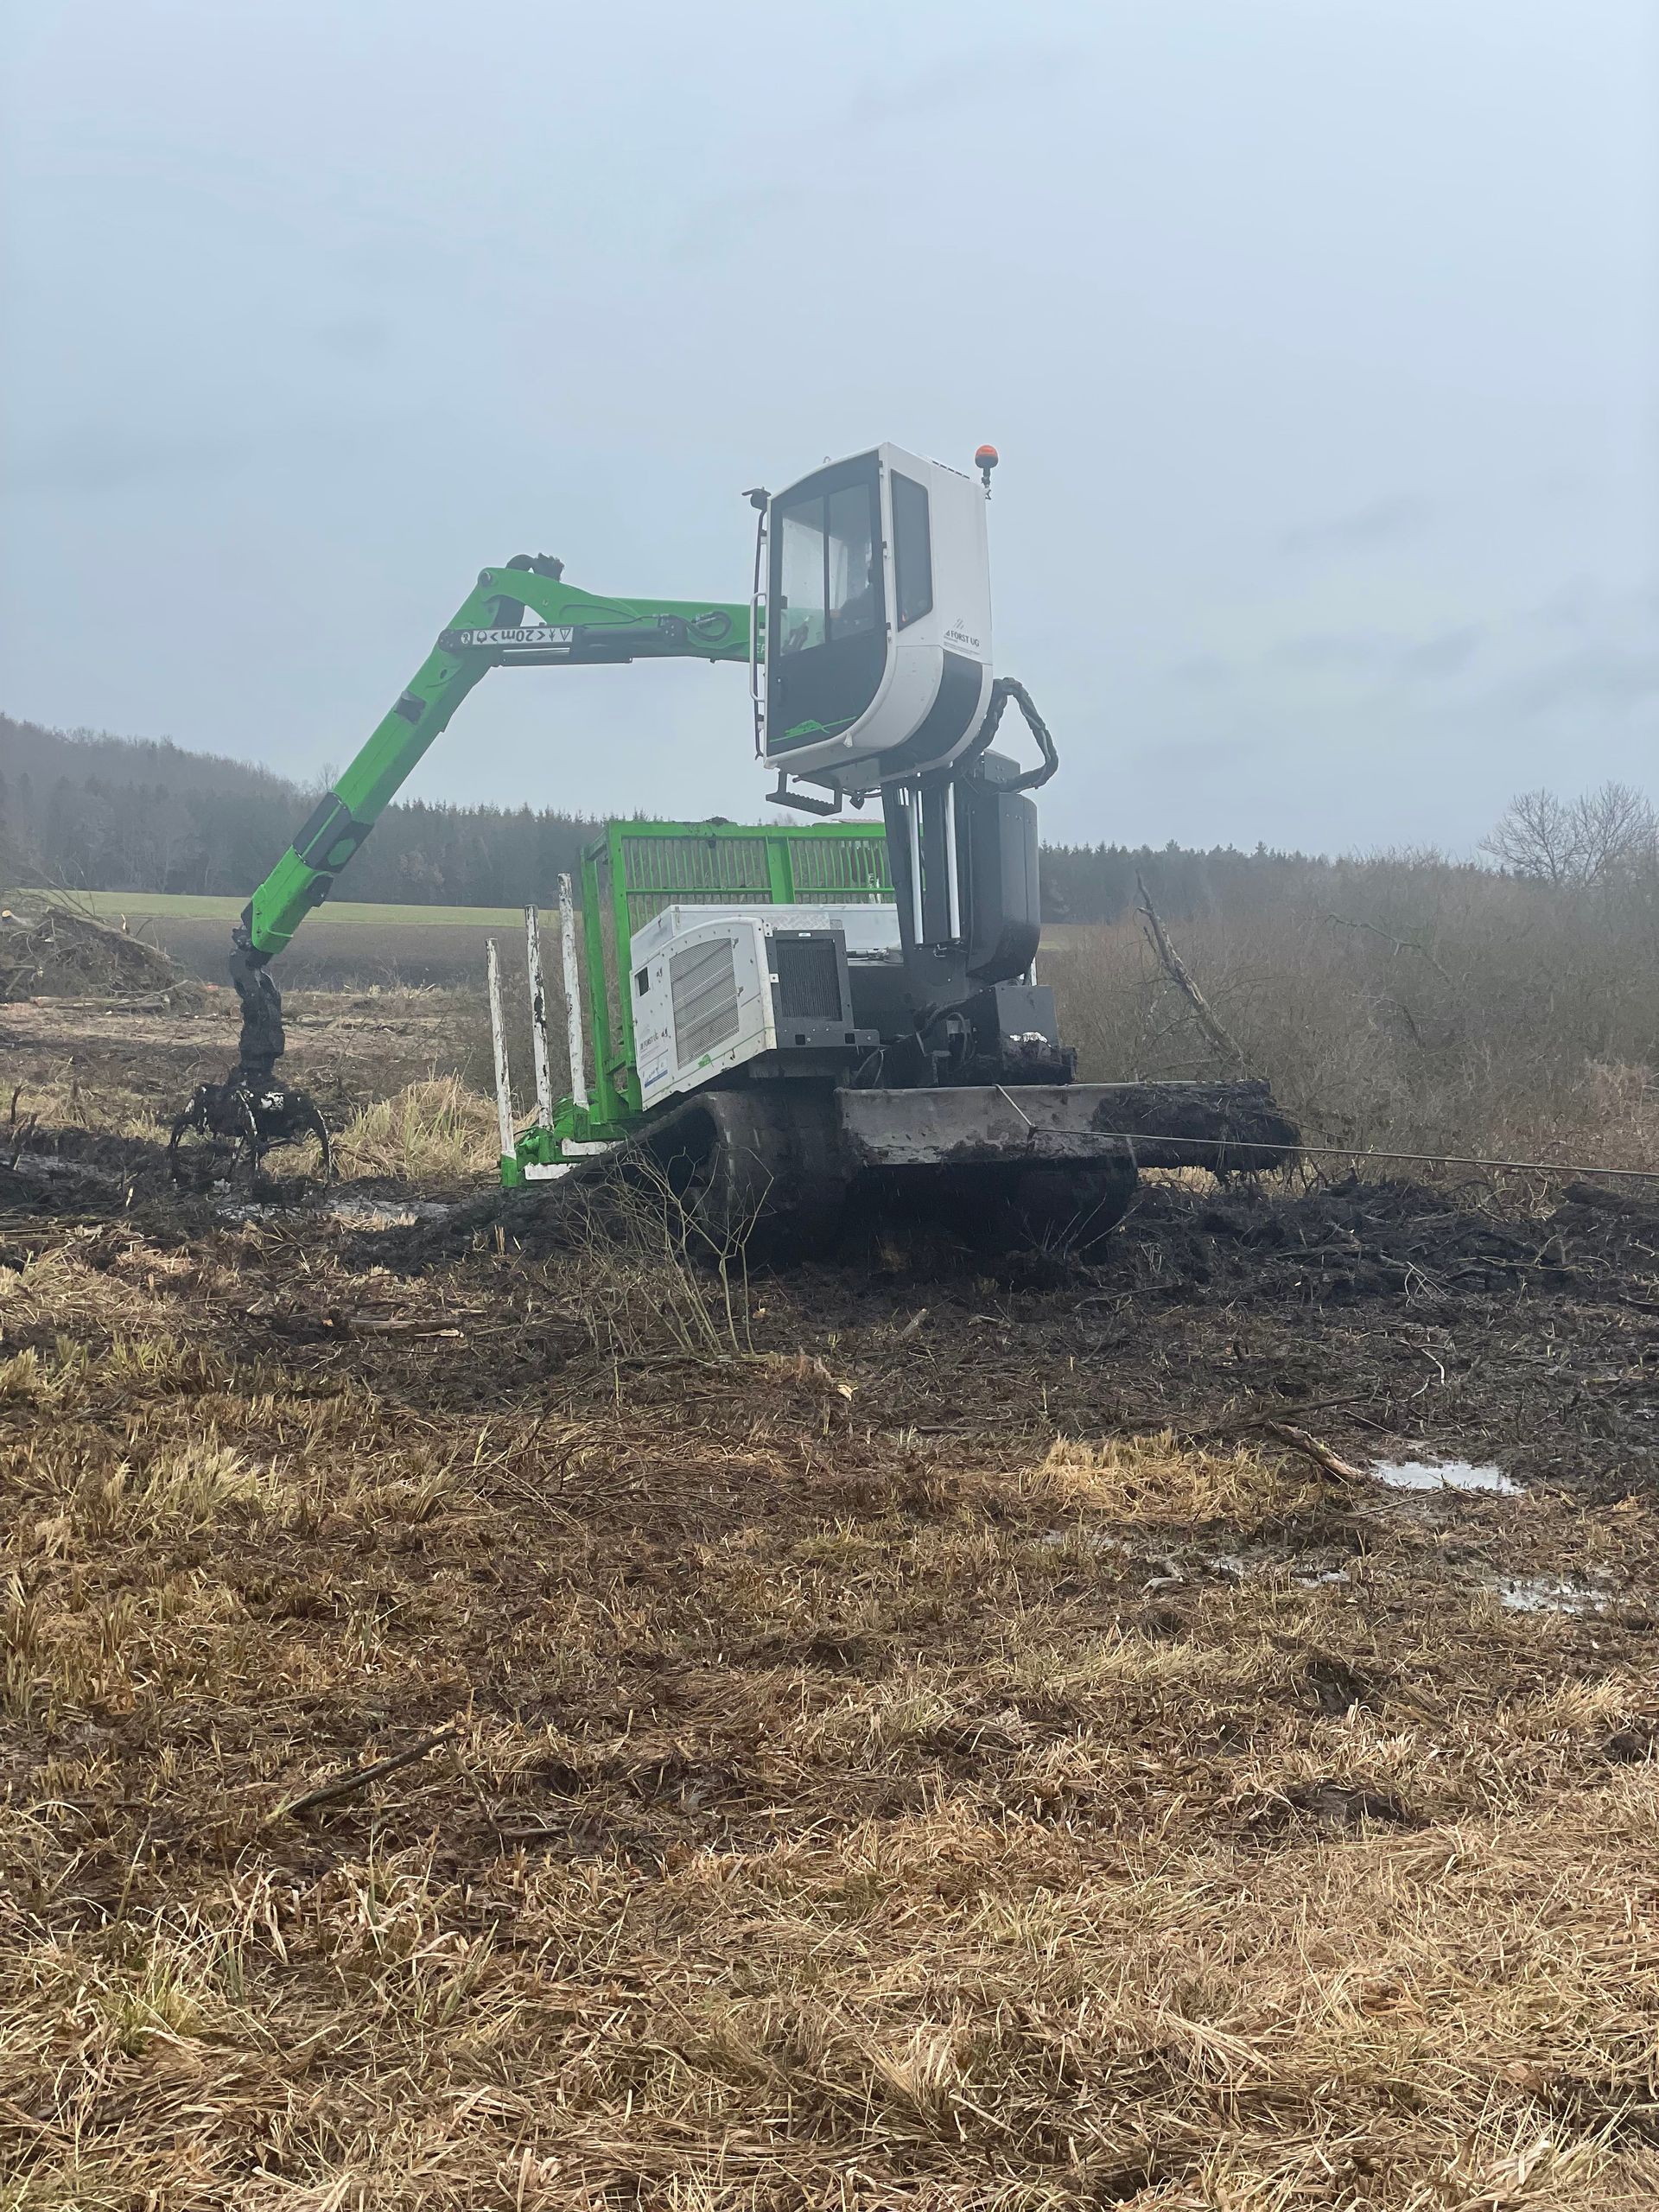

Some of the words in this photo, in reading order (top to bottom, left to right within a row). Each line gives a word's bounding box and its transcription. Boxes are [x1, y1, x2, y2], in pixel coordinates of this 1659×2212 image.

[501, 630, 534, 641] 20m
[950, 631, 969, 643] FORST
[970, 638, 979, 647] UG
